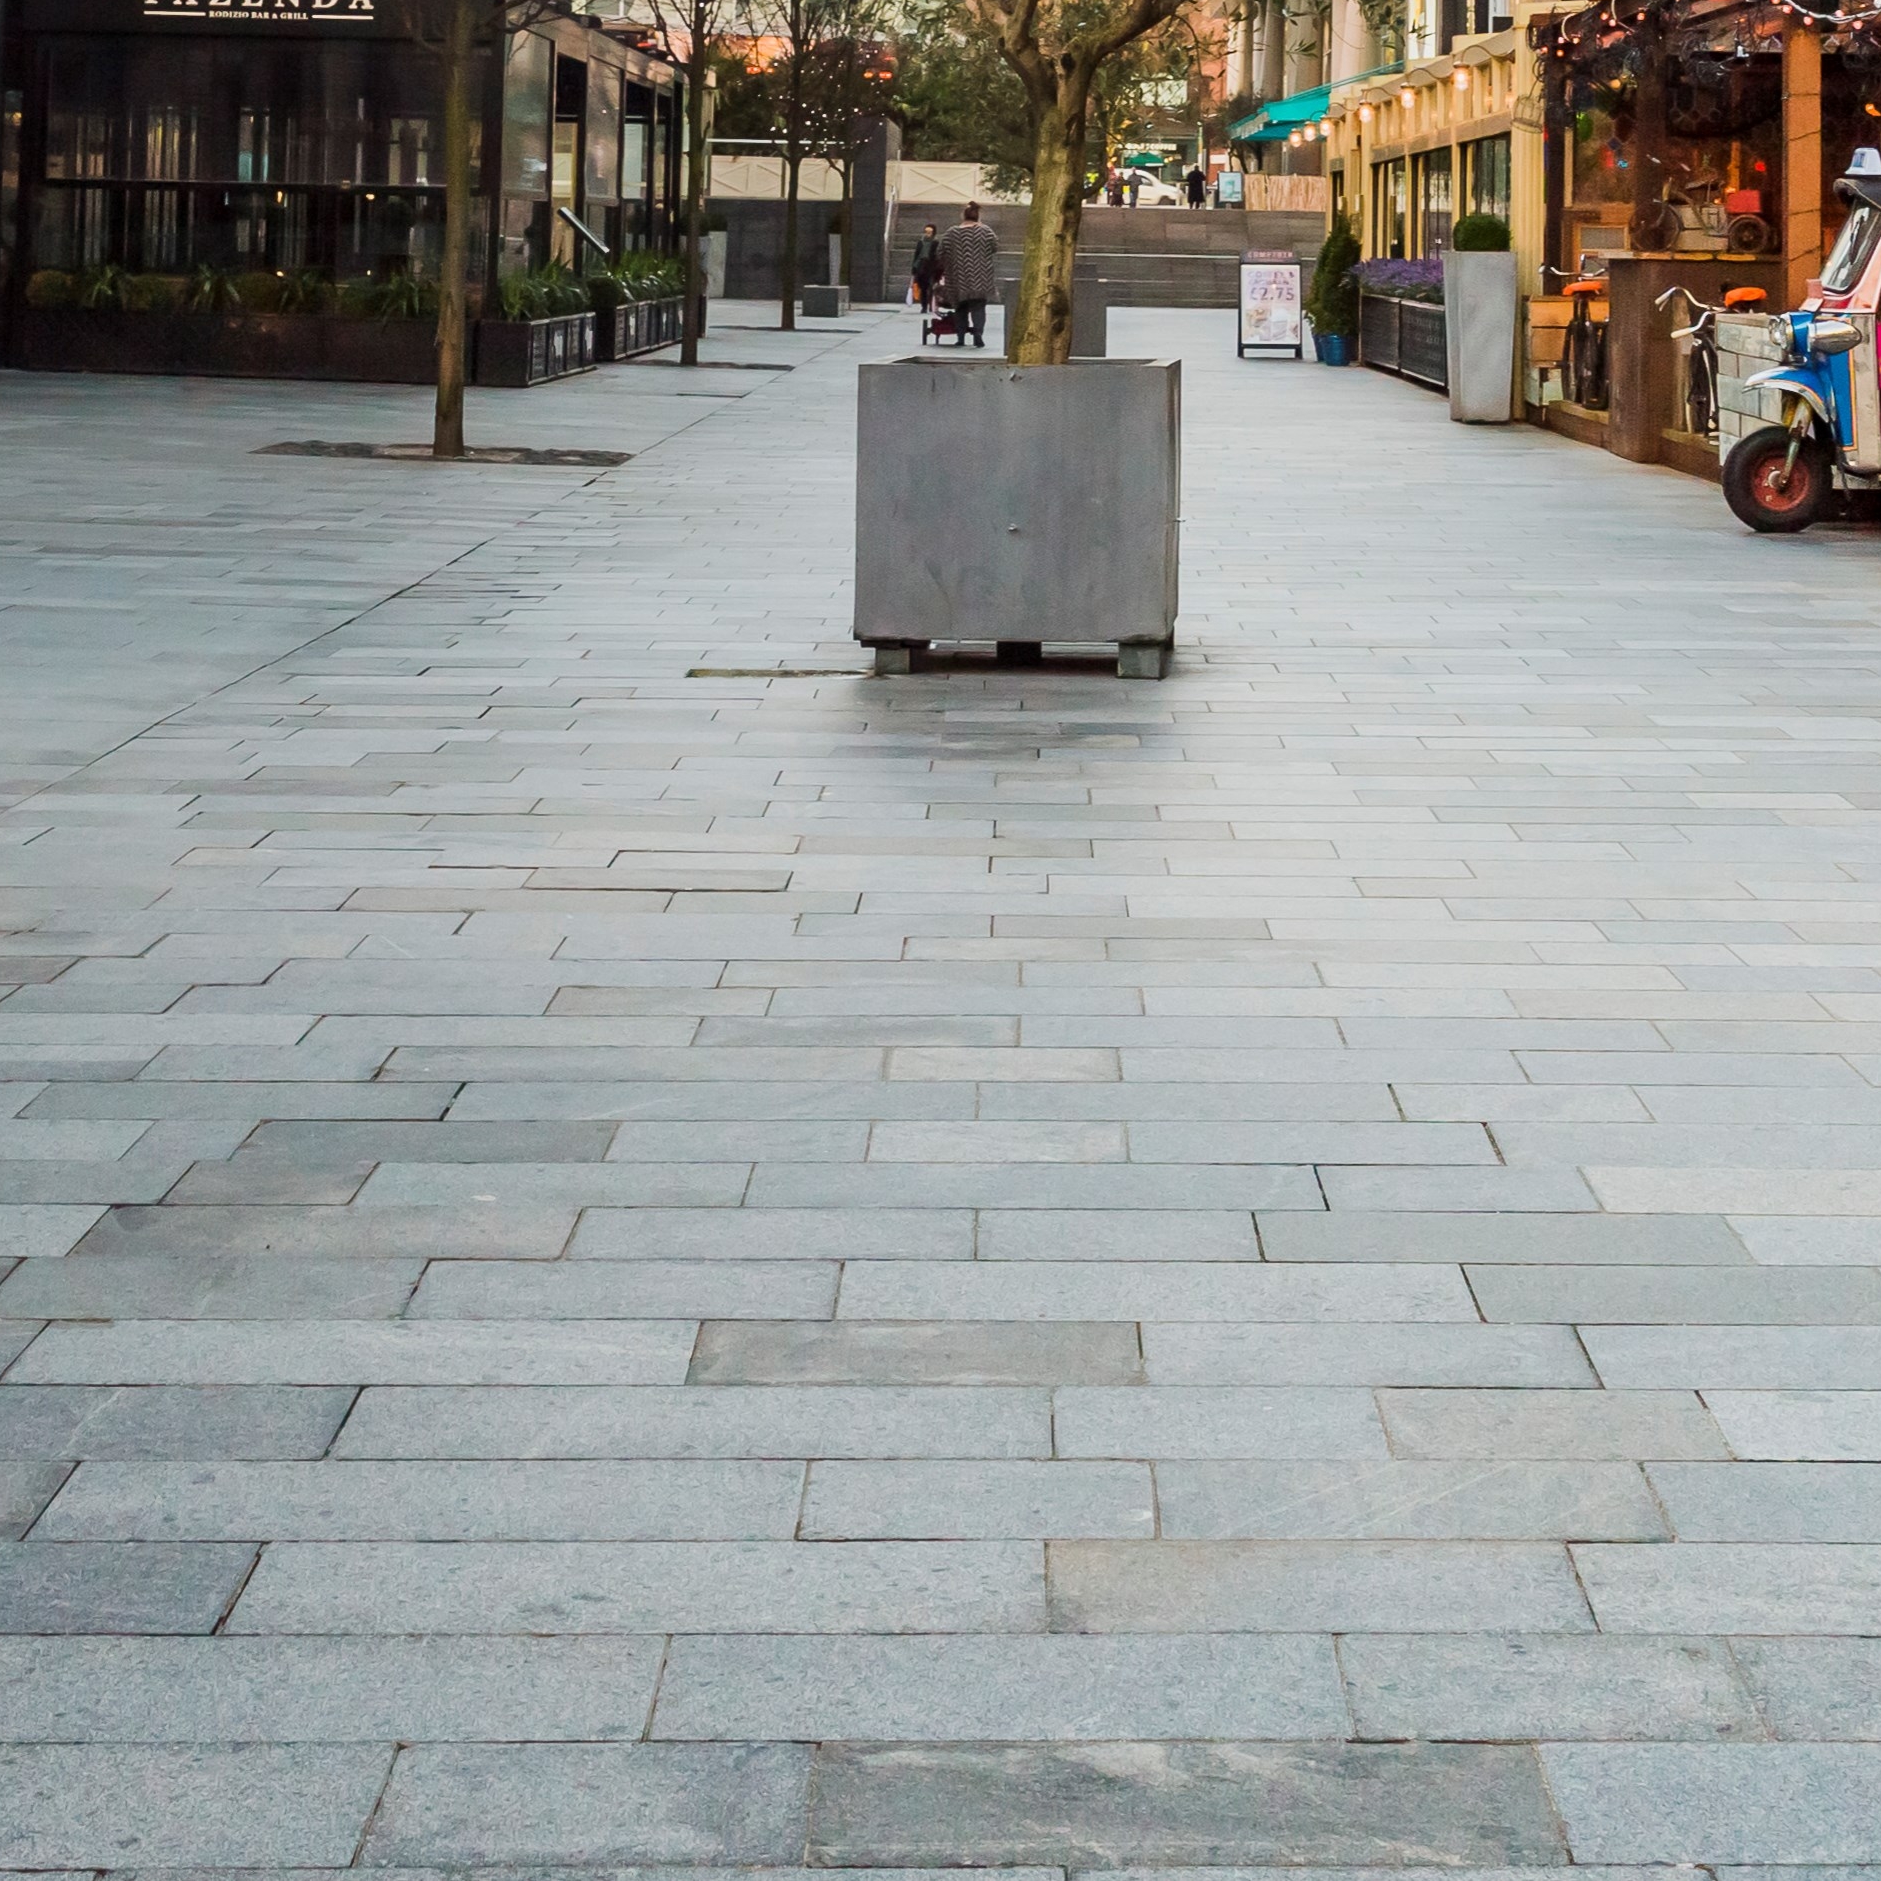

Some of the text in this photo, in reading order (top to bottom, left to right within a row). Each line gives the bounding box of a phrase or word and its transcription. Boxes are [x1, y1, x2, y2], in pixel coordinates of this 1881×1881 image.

[209, 10, 249, 18] RODIZIO
[251, 11, 269, 19] BAR
[280, 12, 309, 20] GRILL
